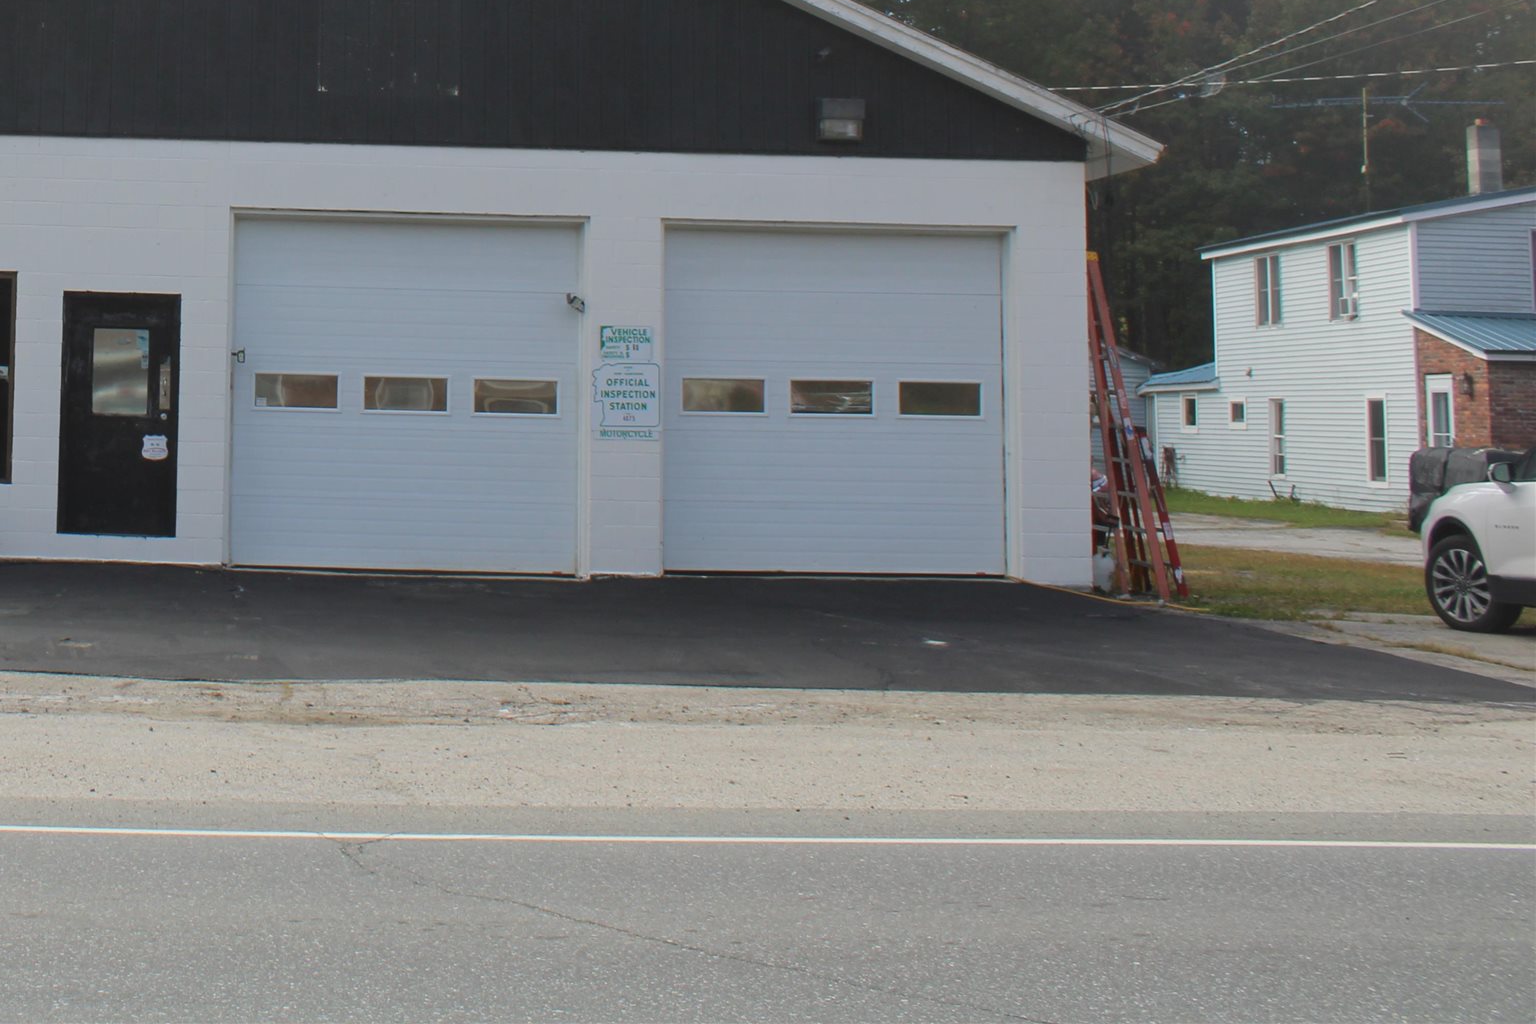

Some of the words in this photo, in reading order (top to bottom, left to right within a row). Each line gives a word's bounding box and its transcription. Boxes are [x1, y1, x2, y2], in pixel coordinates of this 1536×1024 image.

[611, 328, 648, 336] VEHICLE
[606, 378, 650, 387] OFFICIAL
[600, 390, 656, 399] INSPECTION
[609, 402, 647, 411] STATION
[599, 429, 653, 438] MOTORCYCLE
